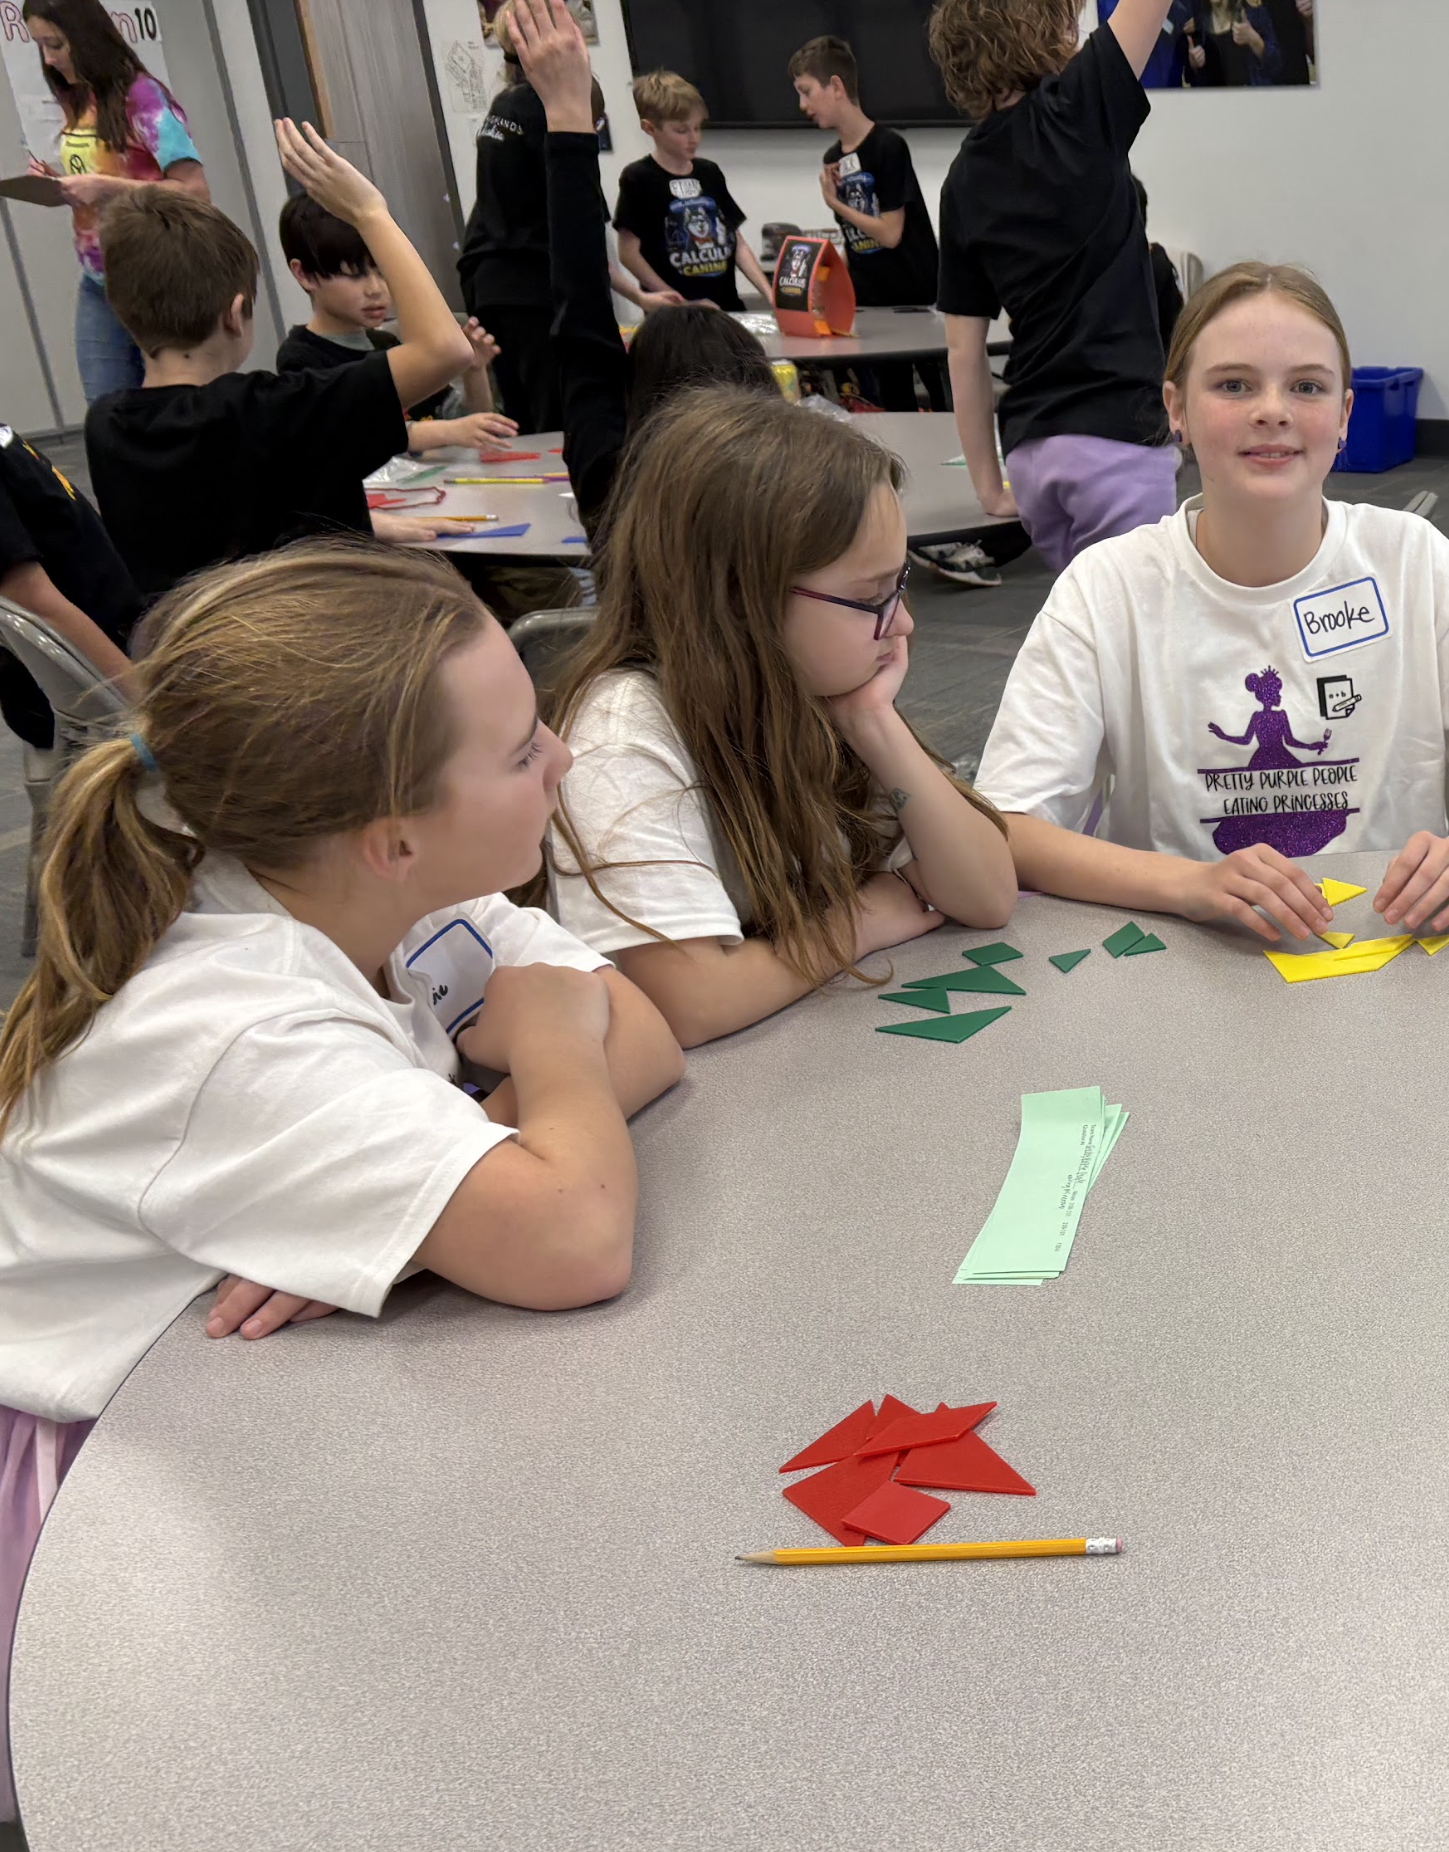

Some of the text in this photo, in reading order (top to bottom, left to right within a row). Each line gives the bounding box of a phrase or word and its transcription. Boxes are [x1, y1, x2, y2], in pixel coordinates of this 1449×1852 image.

[1303, 600, 1375, 635] Brooke
[1205, 765, 1358, 792] PRETTY PURPLE PEOPLE
